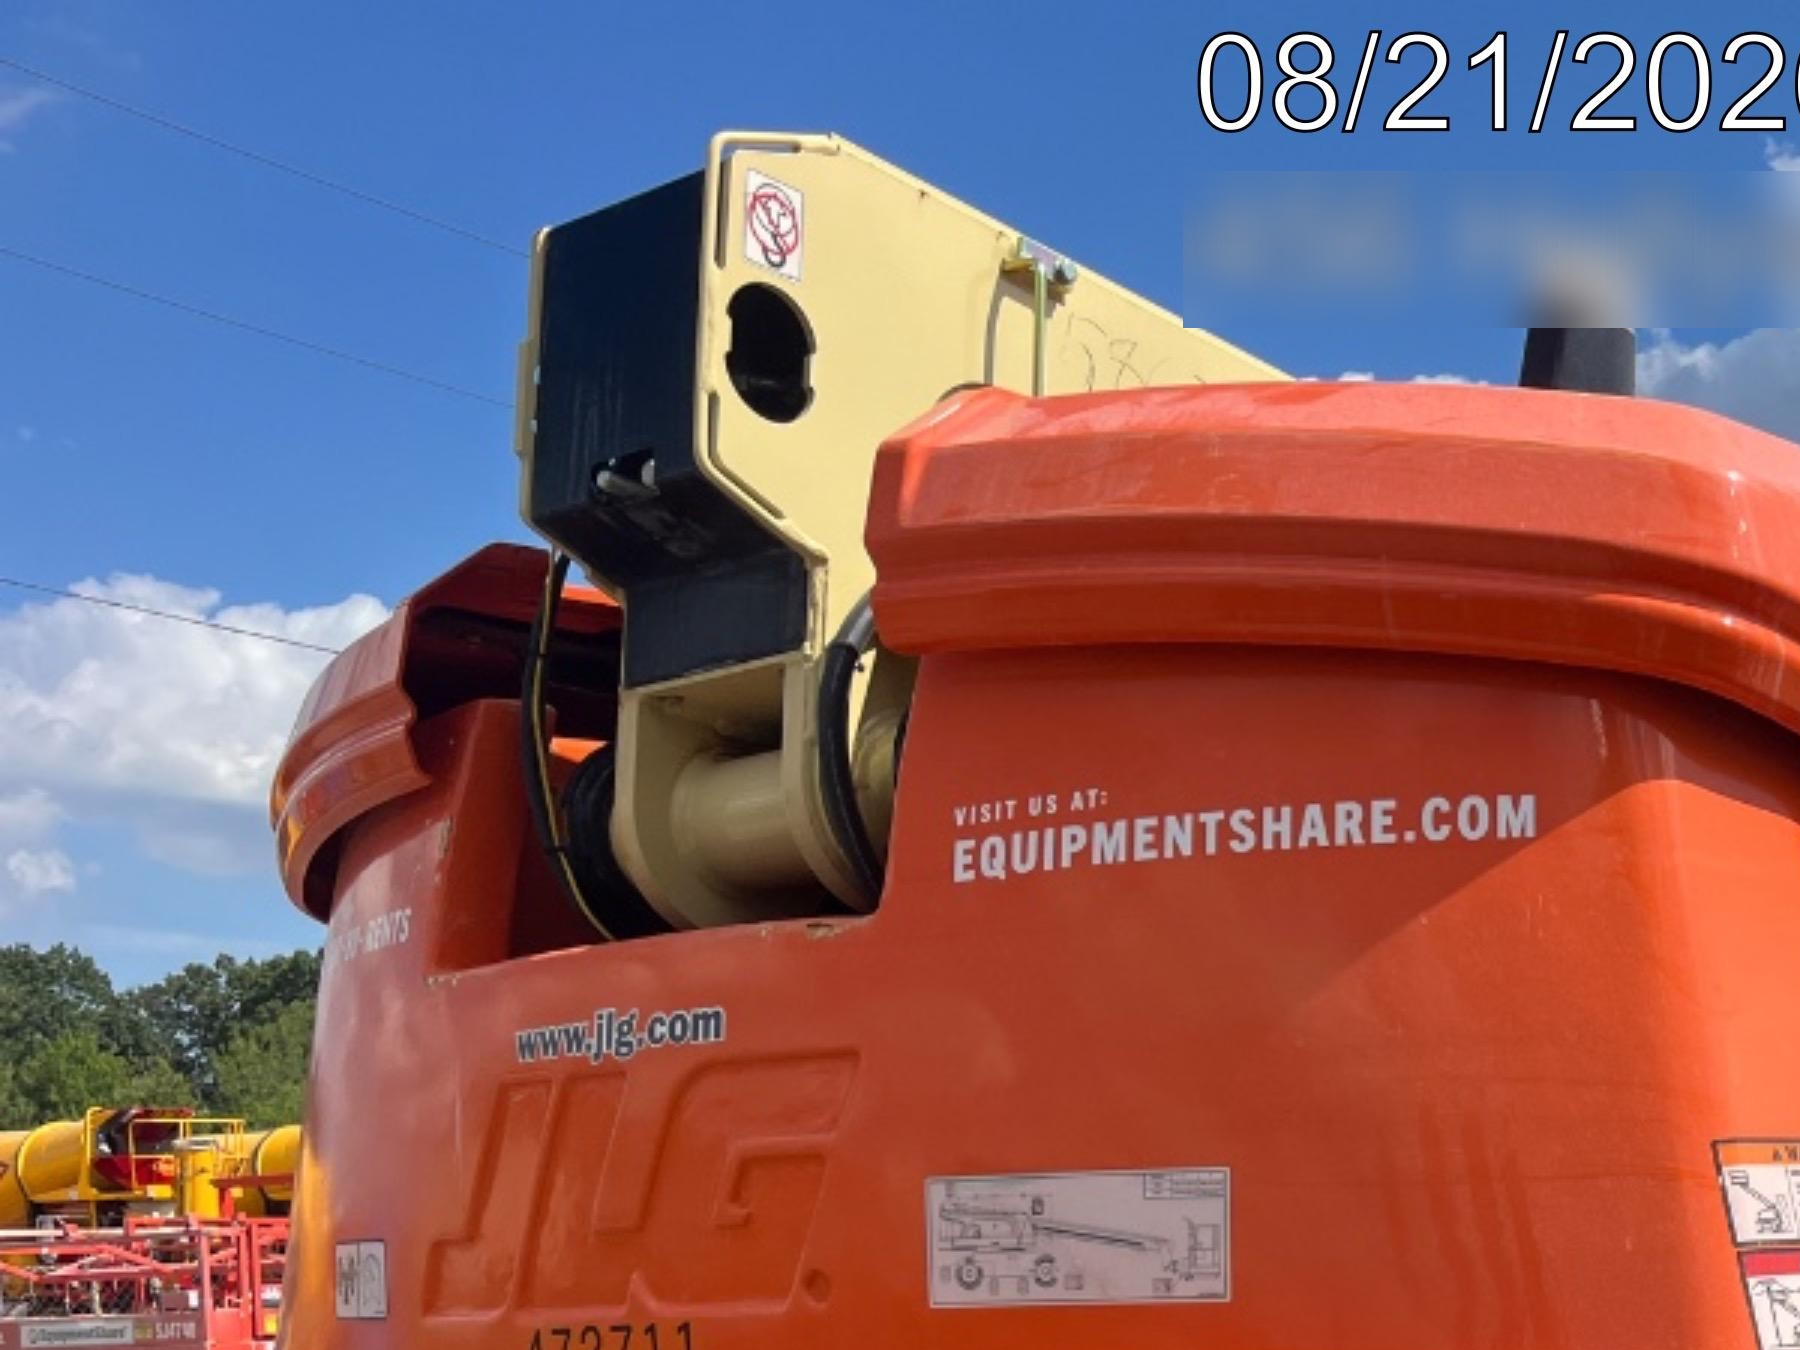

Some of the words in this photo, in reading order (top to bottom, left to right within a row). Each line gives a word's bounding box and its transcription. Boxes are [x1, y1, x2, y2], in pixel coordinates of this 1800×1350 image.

[953, 799, 1018, 827] VISIT
[1028, 794, 1058, 817] US
[1069, 787, 1108, 811] AT:
[953, 793, 1537, 883] EQUIPMENTSHARE.COM
[515, 1006, 727, 1065] www.jlg.com
